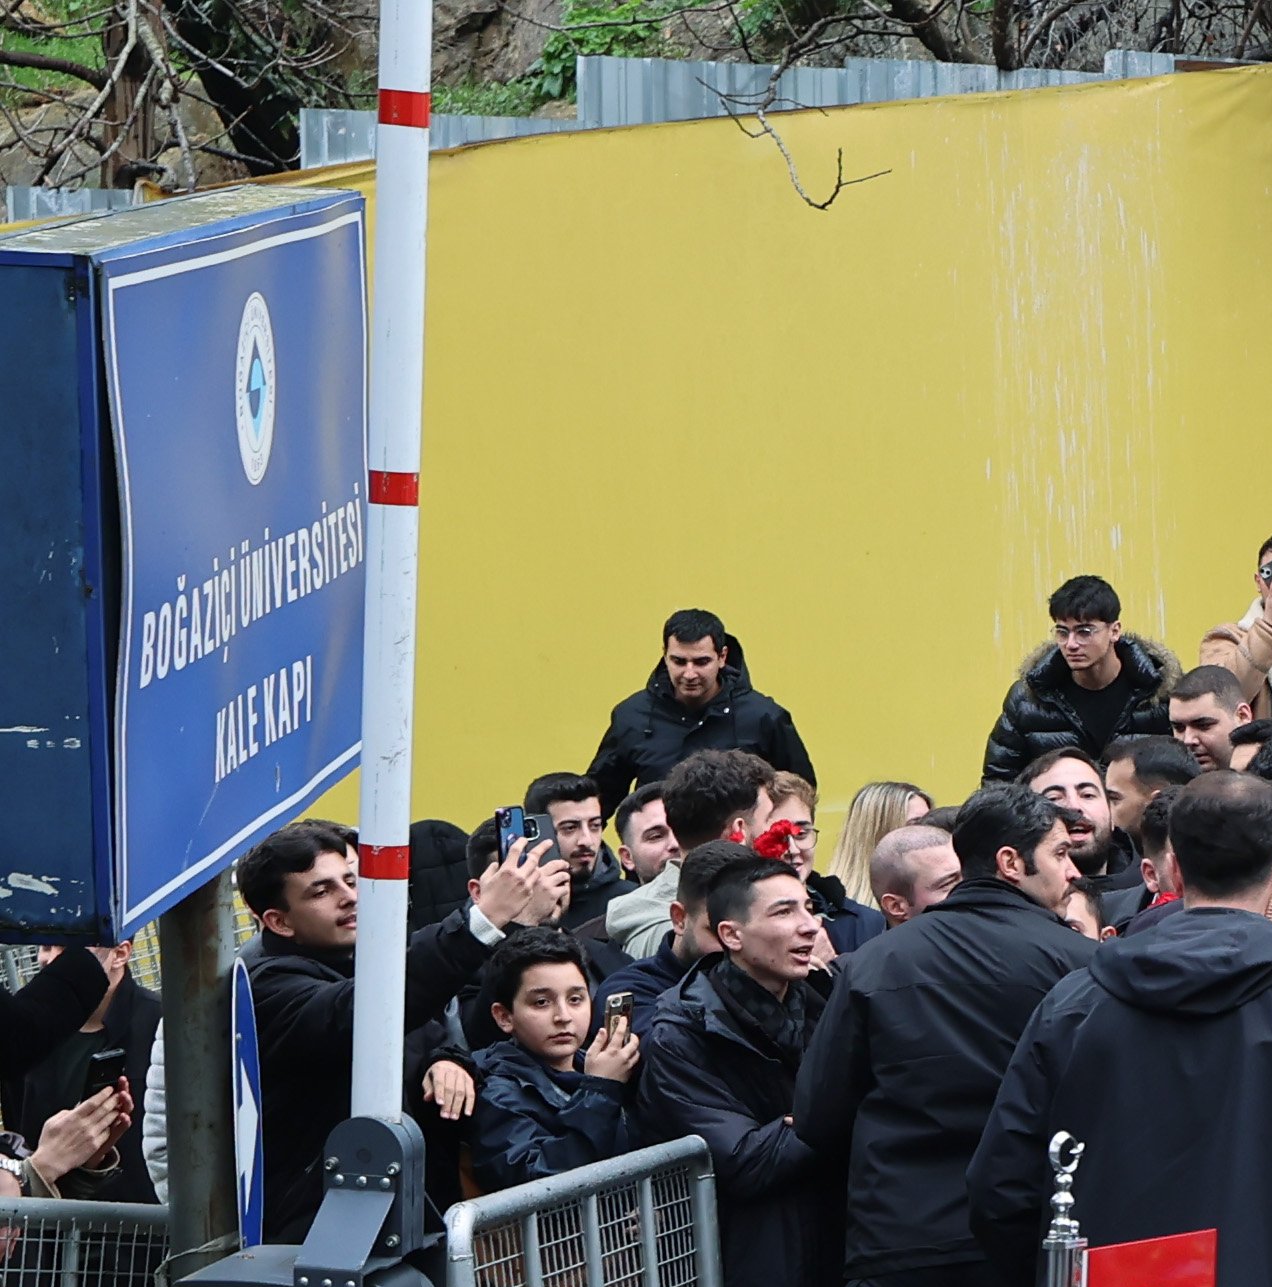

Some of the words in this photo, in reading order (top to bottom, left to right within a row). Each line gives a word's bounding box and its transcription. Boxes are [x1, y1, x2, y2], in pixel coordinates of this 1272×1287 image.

[140, 547, 236, 690] BOĞAZİÇİ
[240, 482, 364, 628] ÜNİVERSİTESİ
[215, 684, 260, 784] KALE
[263, 655, 312, 747] KAPI
